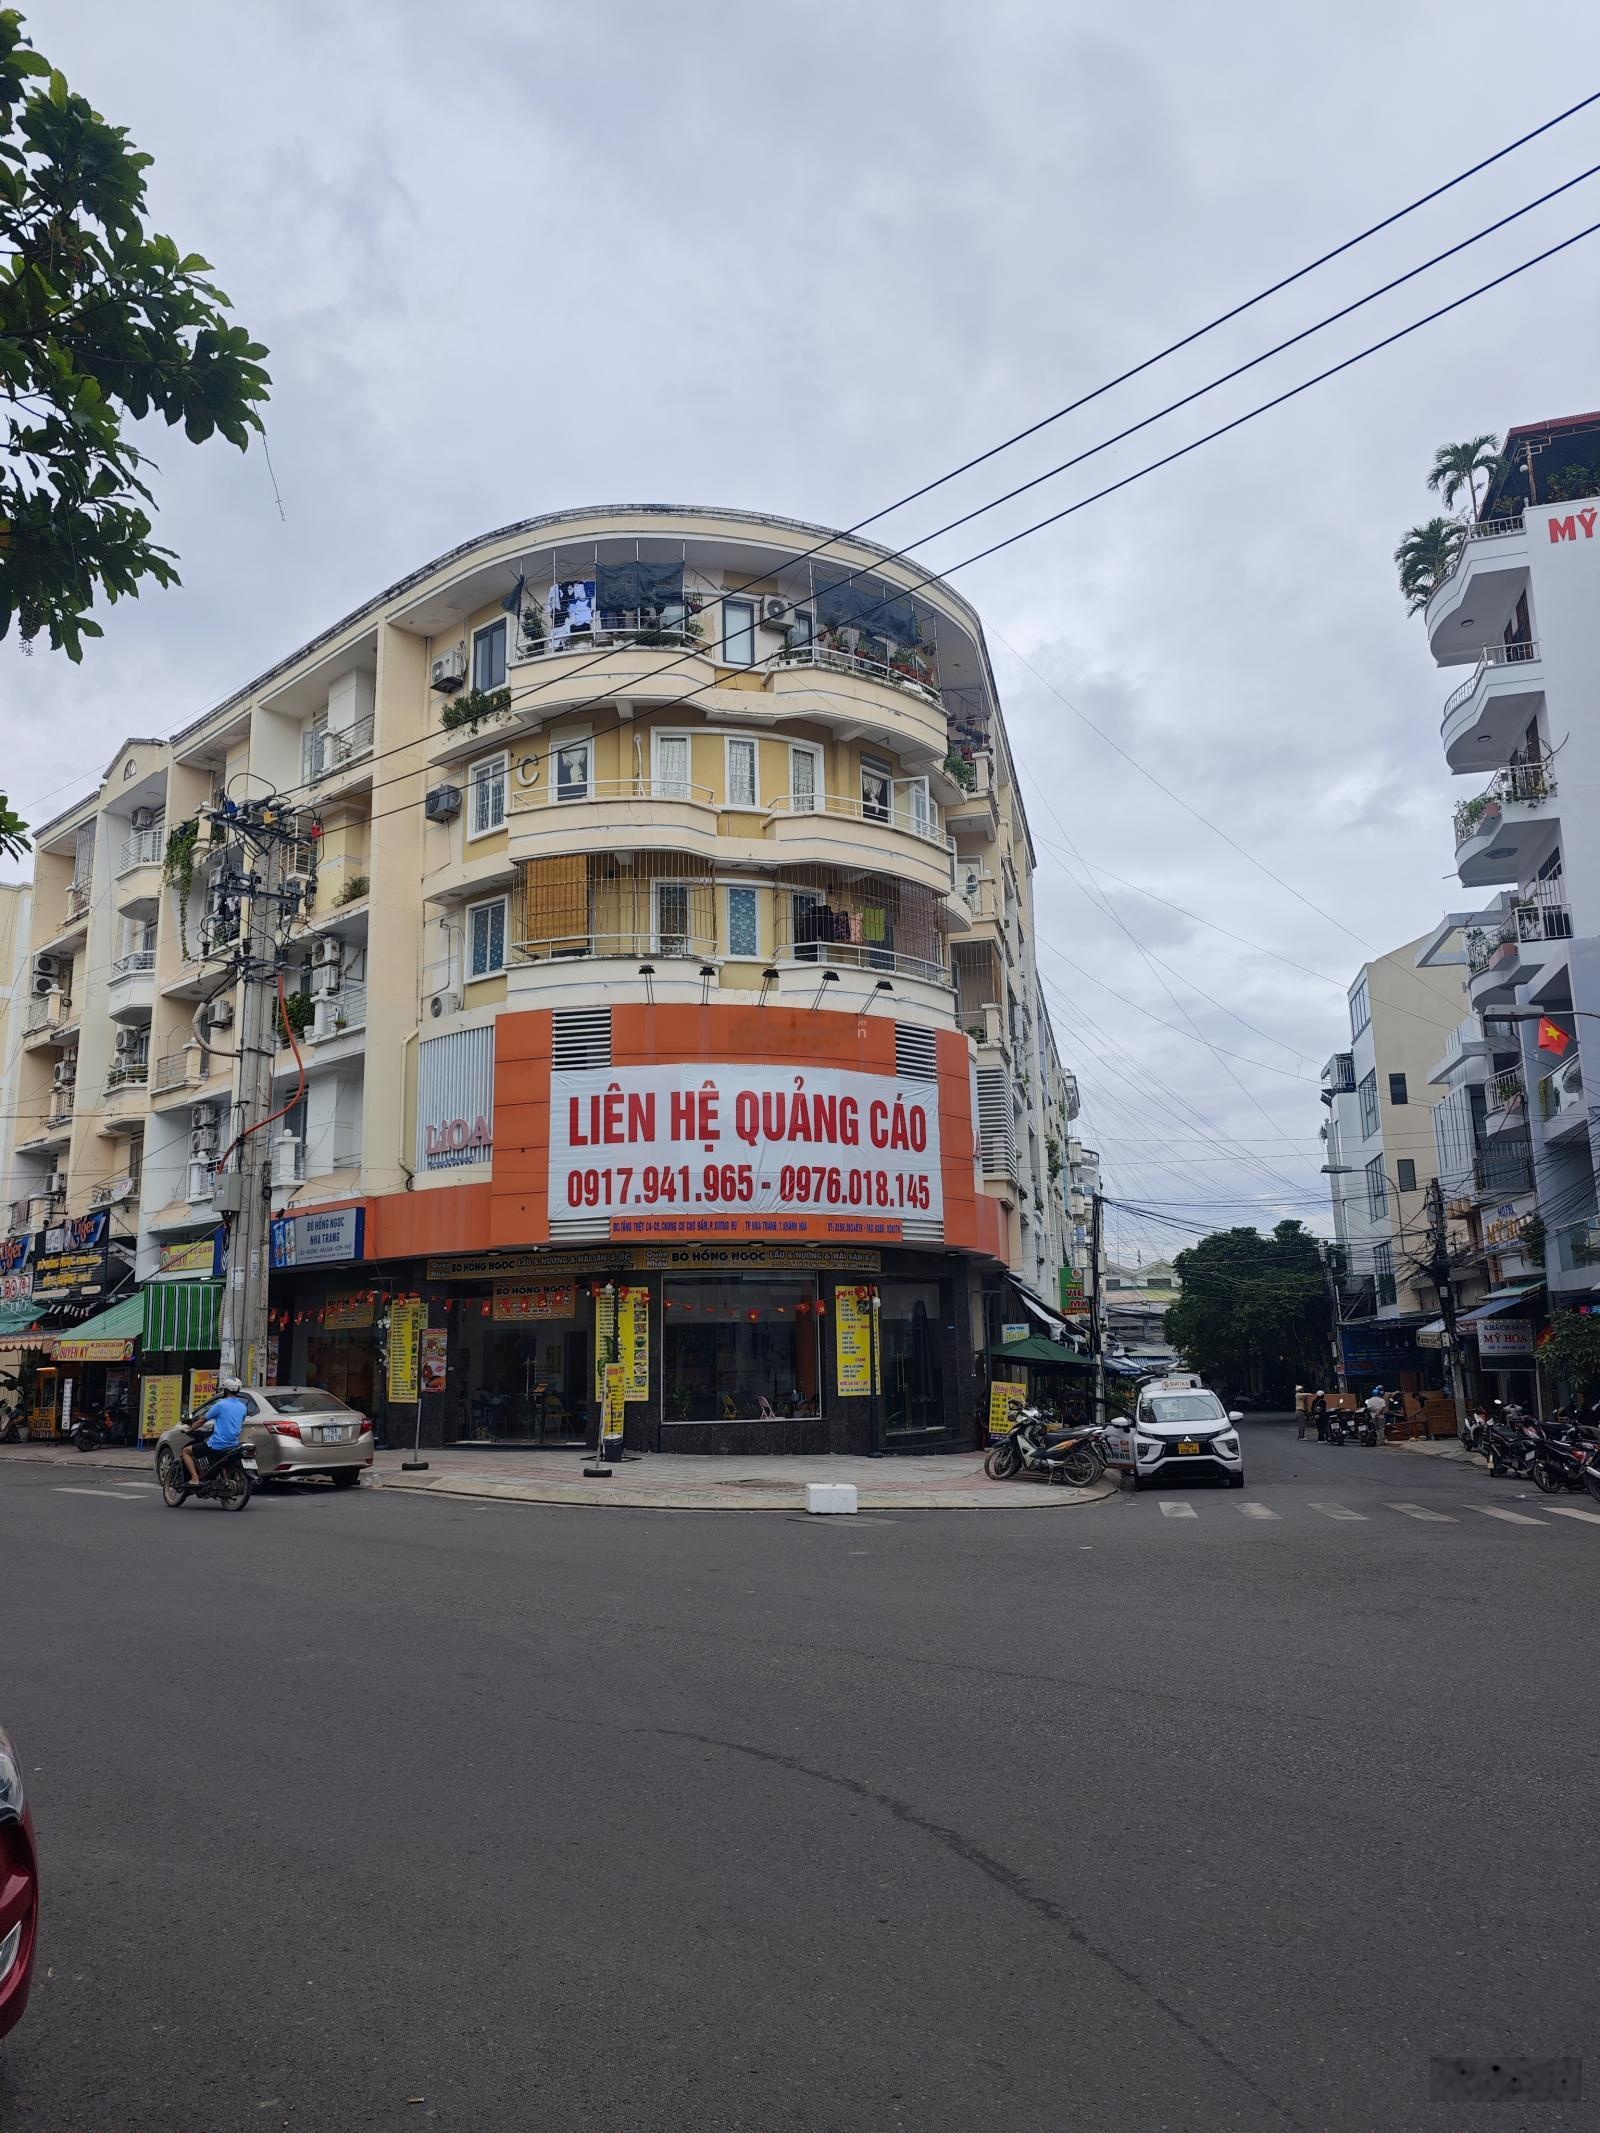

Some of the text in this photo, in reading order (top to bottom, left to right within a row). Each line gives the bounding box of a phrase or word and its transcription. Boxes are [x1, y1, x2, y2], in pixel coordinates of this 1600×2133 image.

[1548, 507, 1598, 543] MỸ
[569, 1083, 656, 1147] LIÊN
[671, 1080, 721, 1152] HỆ
[735, 1076, 859, 1148] QUẢNG
[869, 1093, 927, 1153] CÁO
[567, 1164, 754, 1208] 0917.941.965
[780, 1165, 931, 1210] 0976.018.145
[73, 1217, 96, 1242] Tiger
[322, 1231, 340, 1244] TRANG
[1483, 1332, 1527, 1343] MỸ HOA
